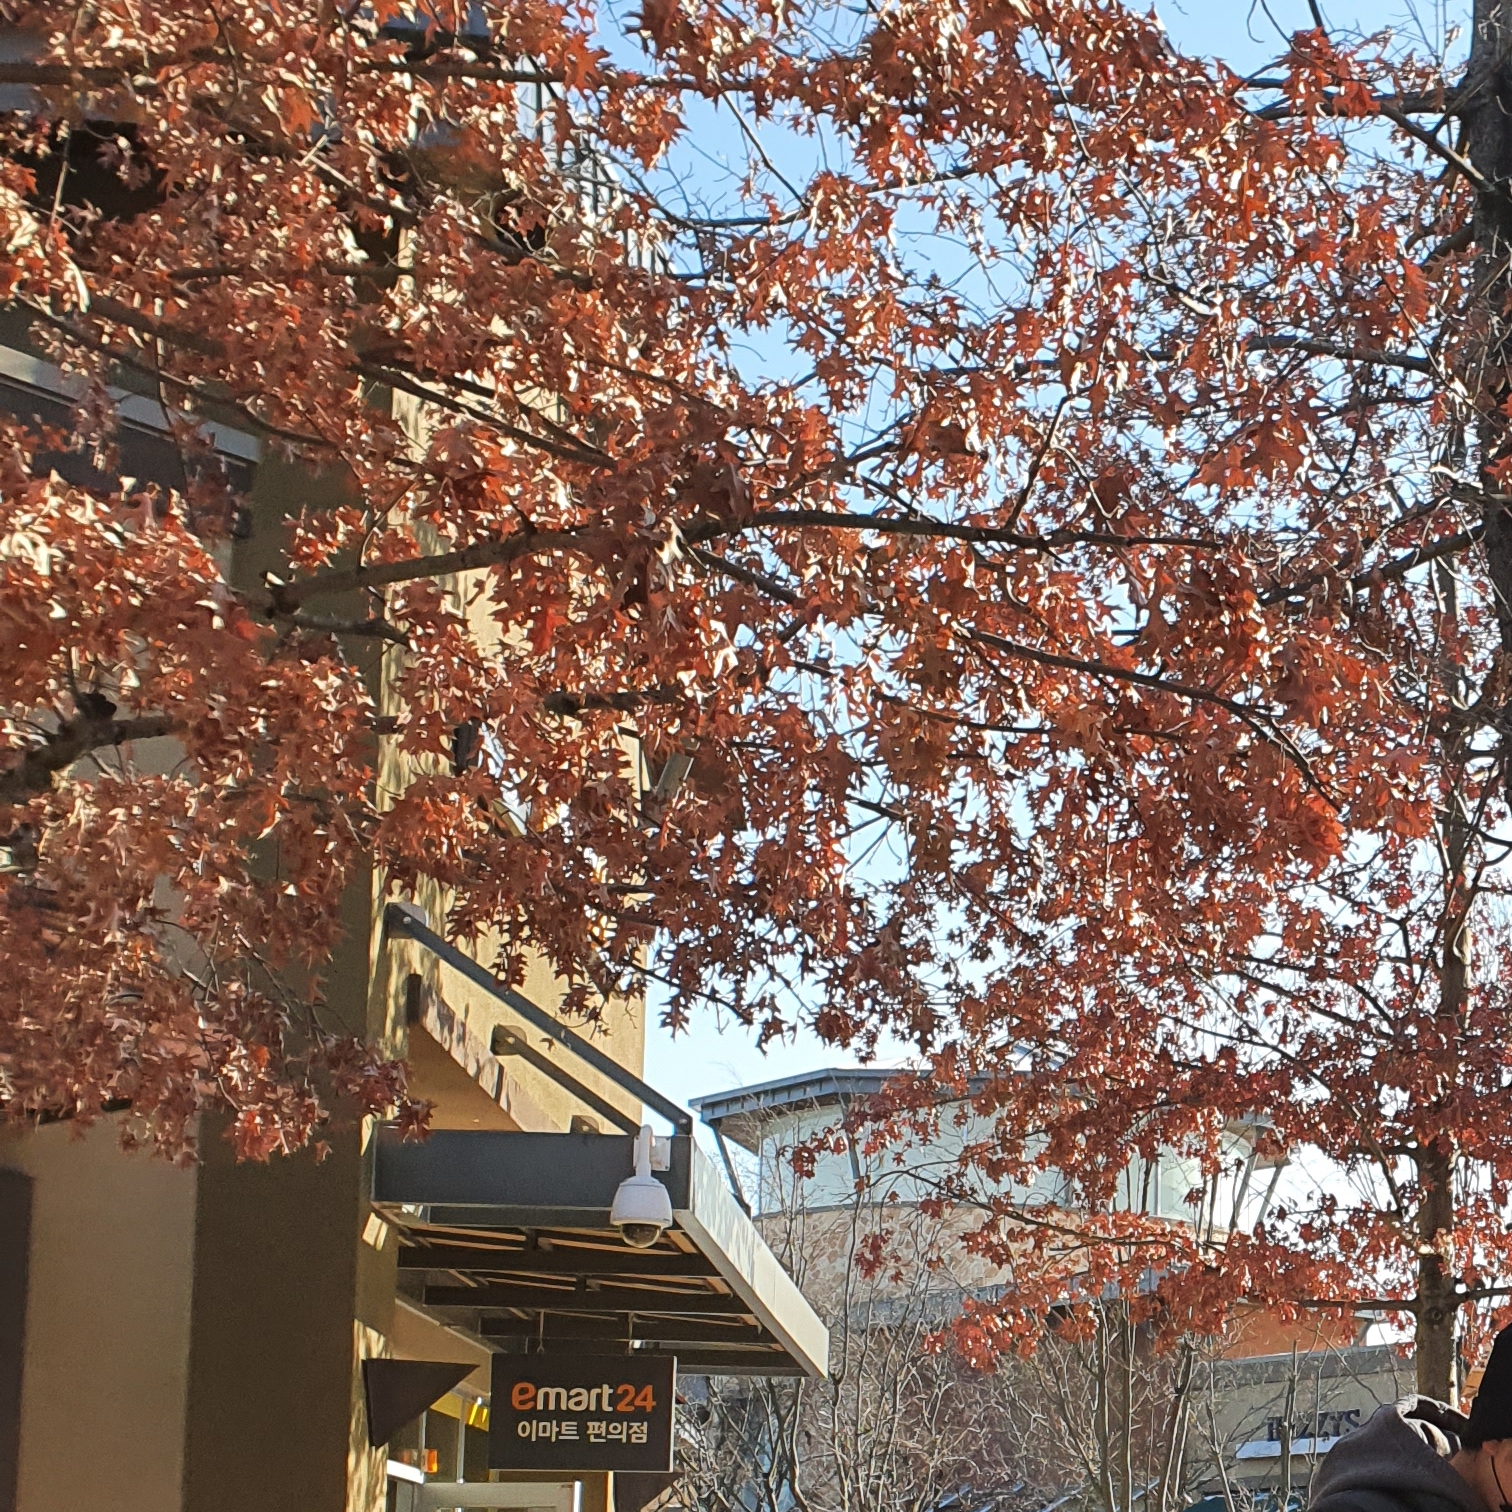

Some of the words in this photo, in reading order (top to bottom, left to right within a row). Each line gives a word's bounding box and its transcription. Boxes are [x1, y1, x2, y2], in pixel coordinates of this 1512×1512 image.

[511, 1381, 657, 1413] emart24
[517, 1419, 580, 1443] 이마트
[585, 1420, 648, 1444] 편의점
